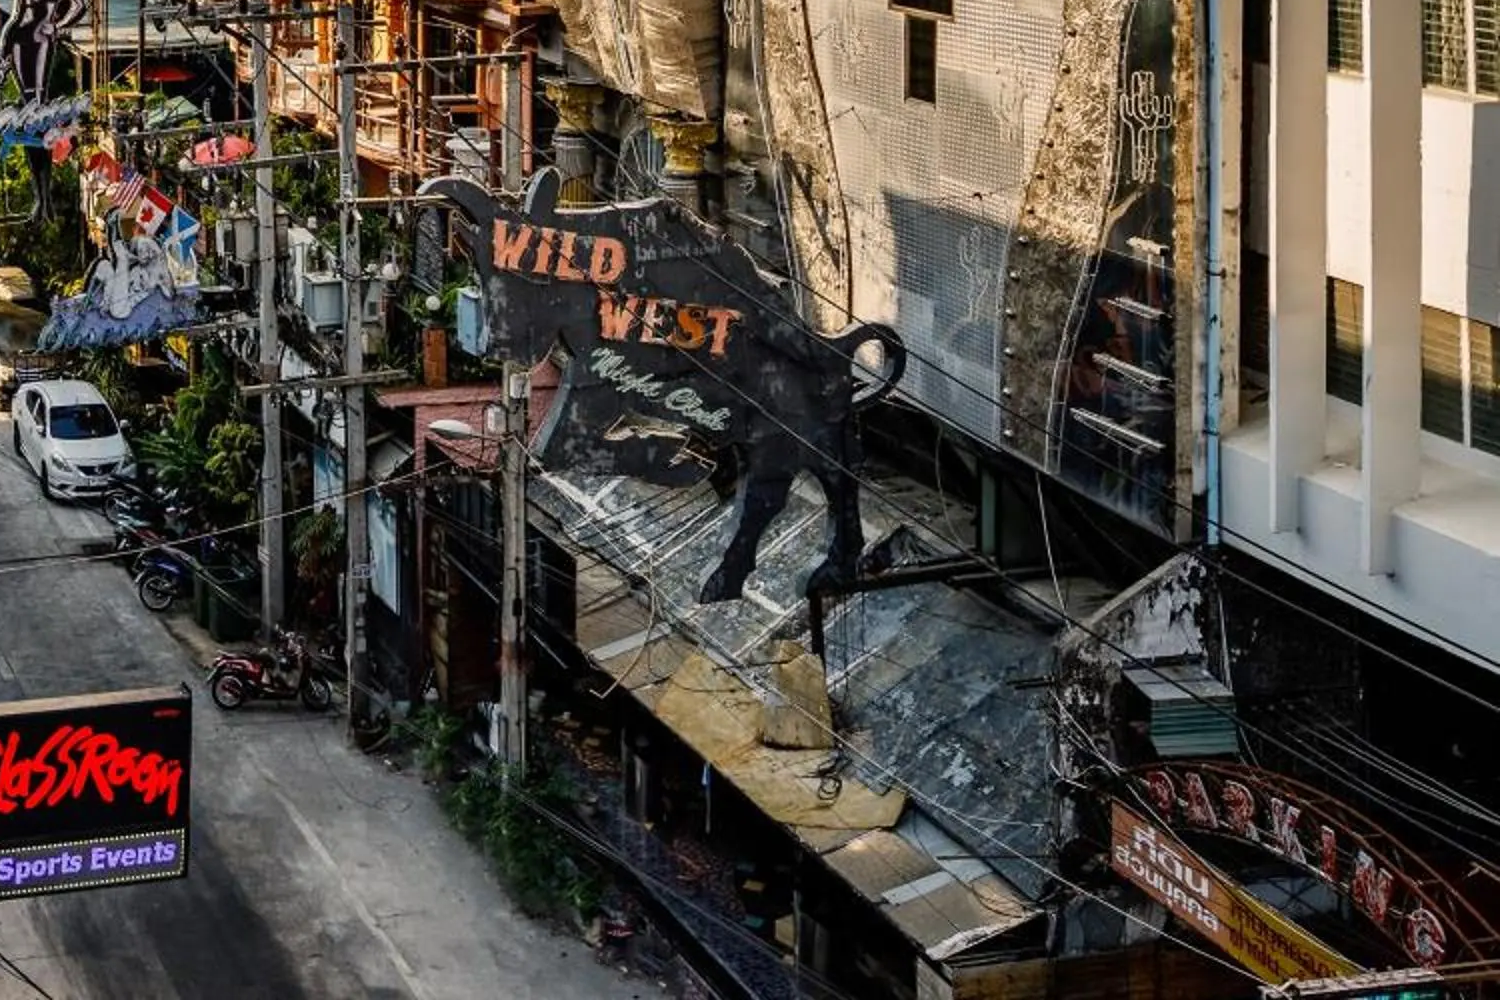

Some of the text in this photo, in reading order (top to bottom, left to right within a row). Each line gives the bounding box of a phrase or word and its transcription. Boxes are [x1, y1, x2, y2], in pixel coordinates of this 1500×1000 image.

[491, 217, 629, 285] WILD
[594, 292, 747, 361] WEST
[90, 840, 177, 871] Events
